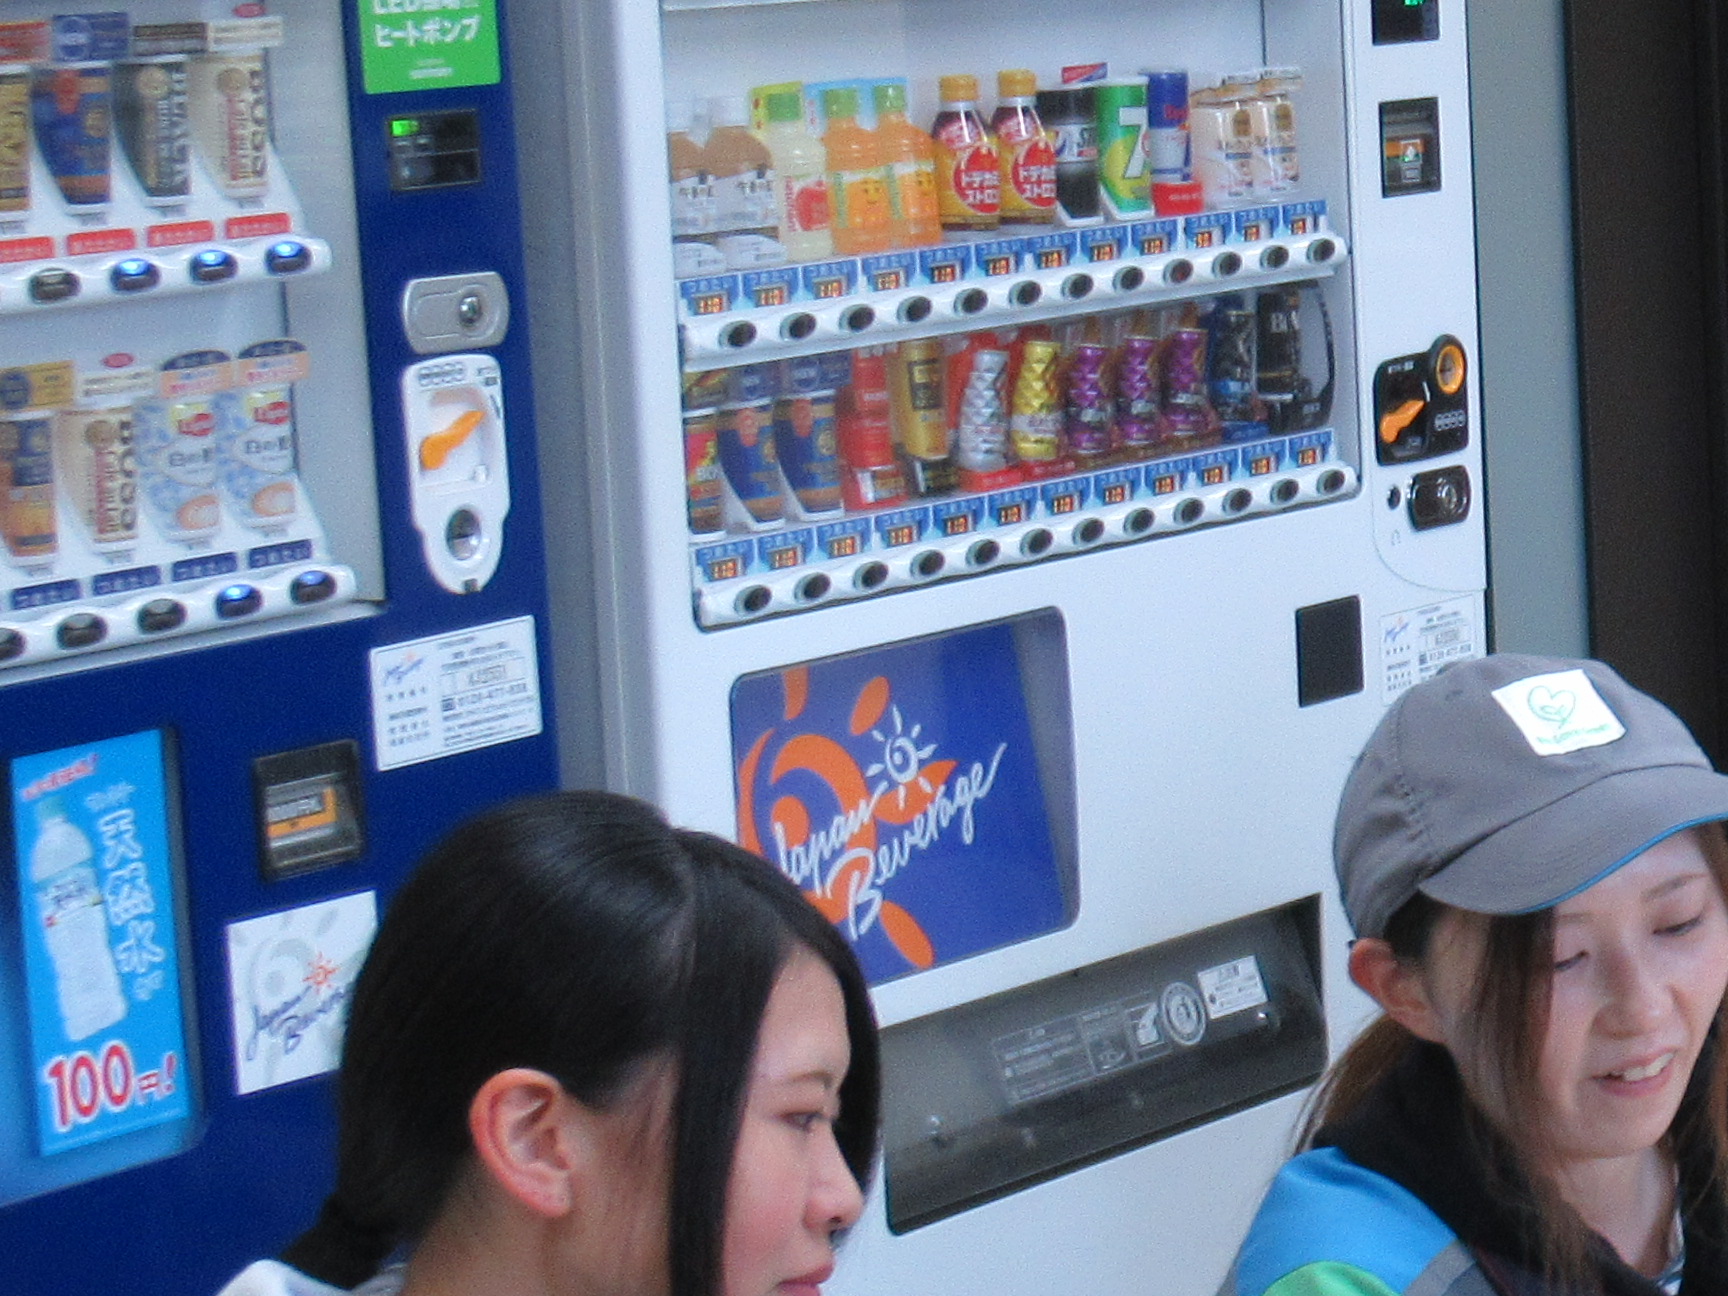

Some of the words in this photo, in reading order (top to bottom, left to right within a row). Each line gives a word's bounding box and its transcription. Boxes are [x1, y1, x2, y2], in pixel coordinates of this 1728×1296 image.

[374, 13, 483, 49] ヒートポンプ
[825, 741, 1009, 942] Beverage
